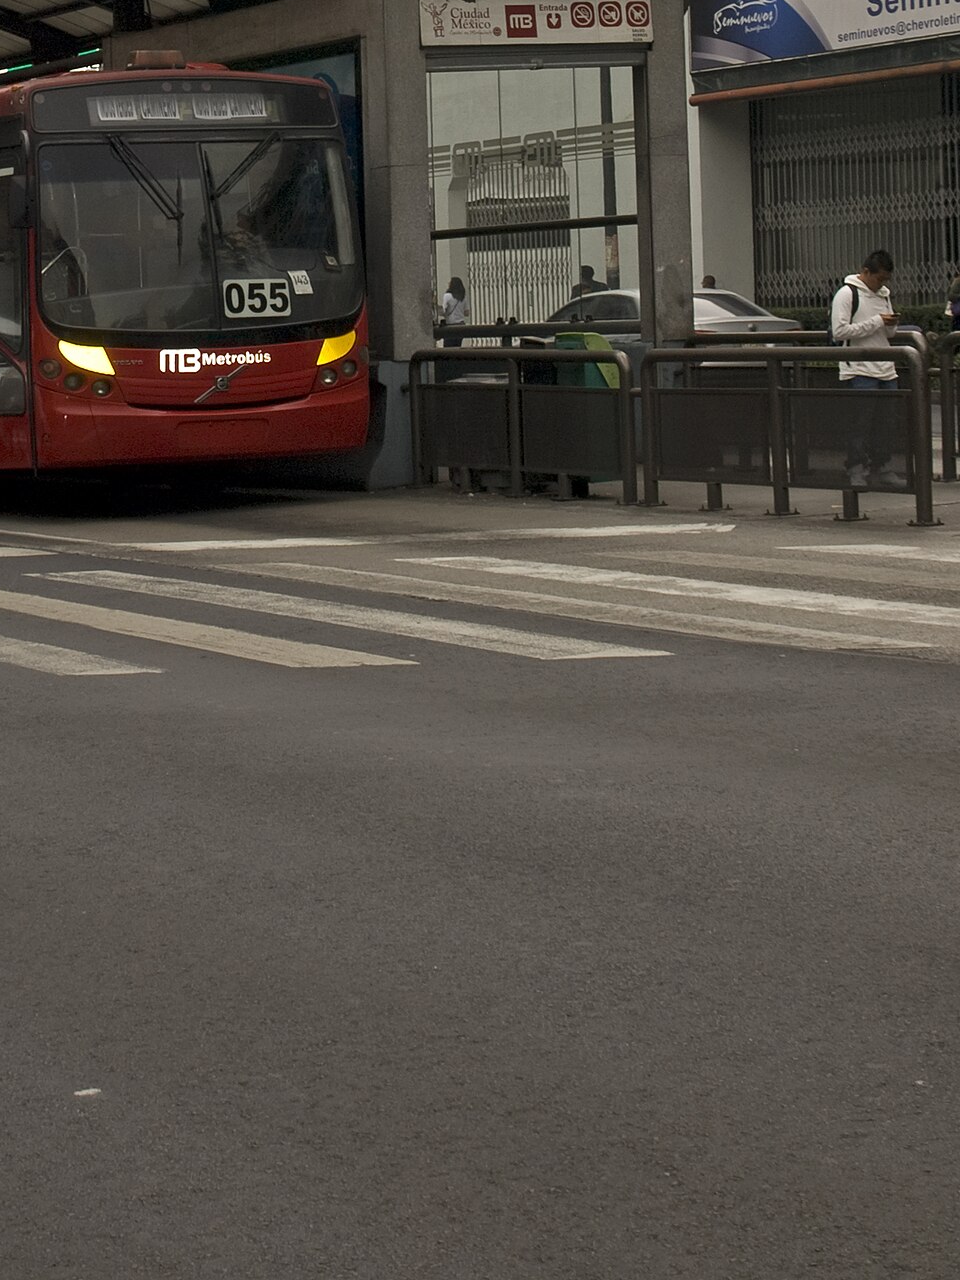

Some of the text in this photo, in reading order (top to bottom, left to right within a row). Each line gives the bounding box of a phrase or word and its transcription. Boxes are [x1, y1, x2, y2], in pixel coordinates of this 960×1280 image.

[450, 7, 490, 19] Ciudad
[539, 4, 568, 12] Entrada
[451, 19, 492, 30] México
[225, 283, 289, 314] 055
[202, 350, 272, 367] Metrobús
